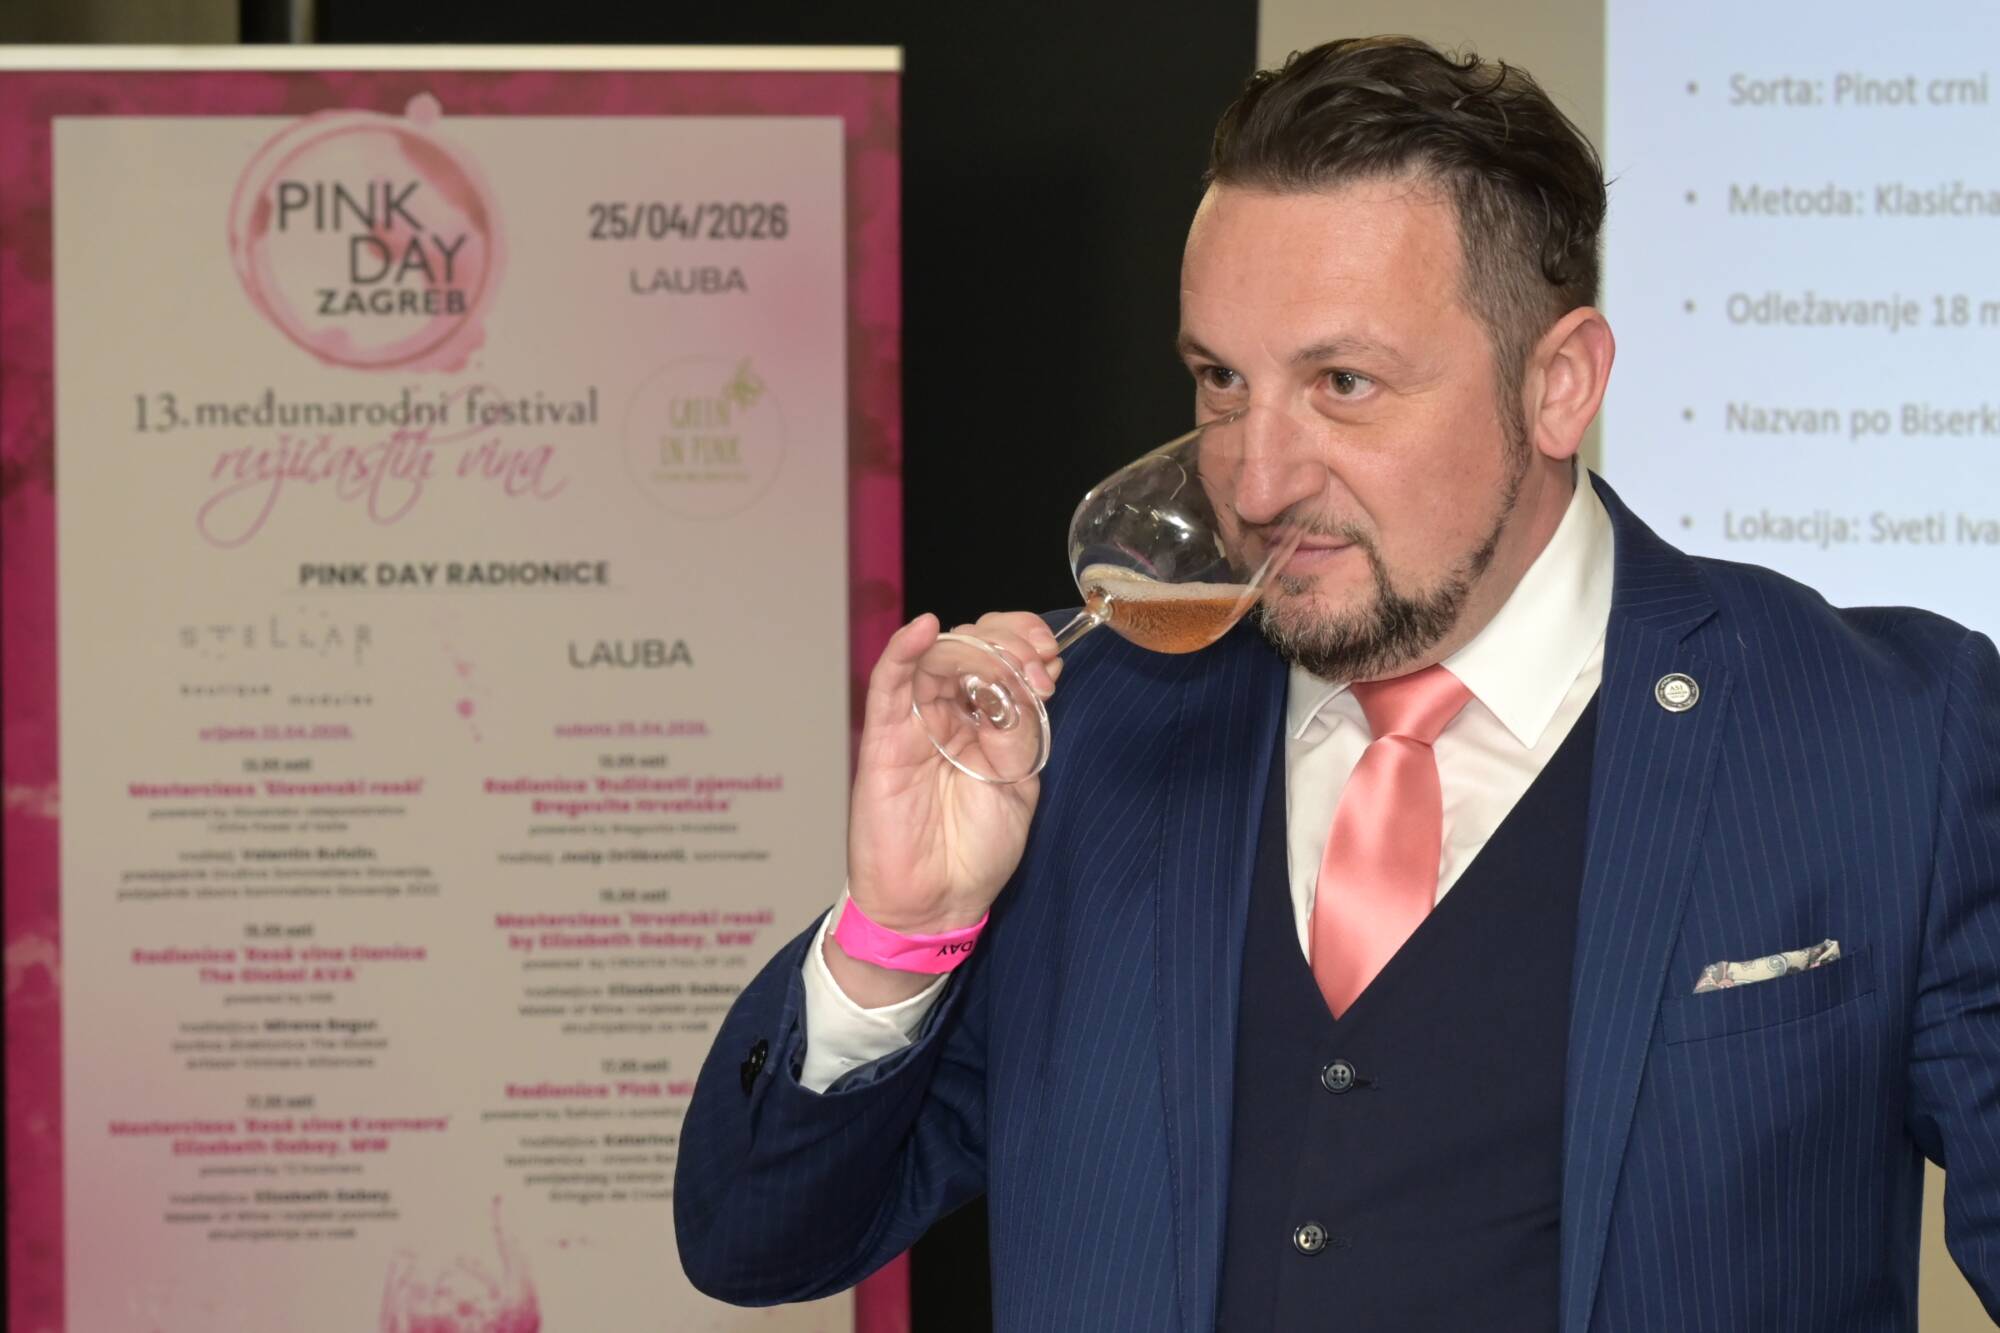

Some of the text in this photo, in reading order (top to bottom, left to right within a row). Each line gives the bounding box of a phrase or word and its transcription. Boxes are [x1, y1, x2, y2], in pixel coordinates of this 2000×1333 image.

[1729, 72, 1988, 106] Sorta: Pinot crni
[277, 182, 421, 232] PINK
[1728, 183, 1864, 216] Metoda:
[589, 203, 788, 240] 25/04/2026
[349, 234, 467, 285] DAY
[630, 267, 748, 294] LAUBA
[317, 290, 468, 316] ZAGREB
[1726, 290, 1920, 333] Odležavanje
[1932, 295, 1969, 327] 18
[466, 388, 598, 425] festival
[1726, 400, 2000, 441] Nazvan po Biserk
[1725, 510, 1858, 549] Lokacija:
[1870, 511, 1945, 543] Sveti
[300, 561, 609, 585] PINK DAY RADIONICE
[568, 640, 693, 668] LAUBA
[128, 783, 256, 797] Masterclass
[495, 912, 620, 928] Masterclass
[936, 941, 974, 957] DAY
[108, 1120, 237, 1135] Masterclass
